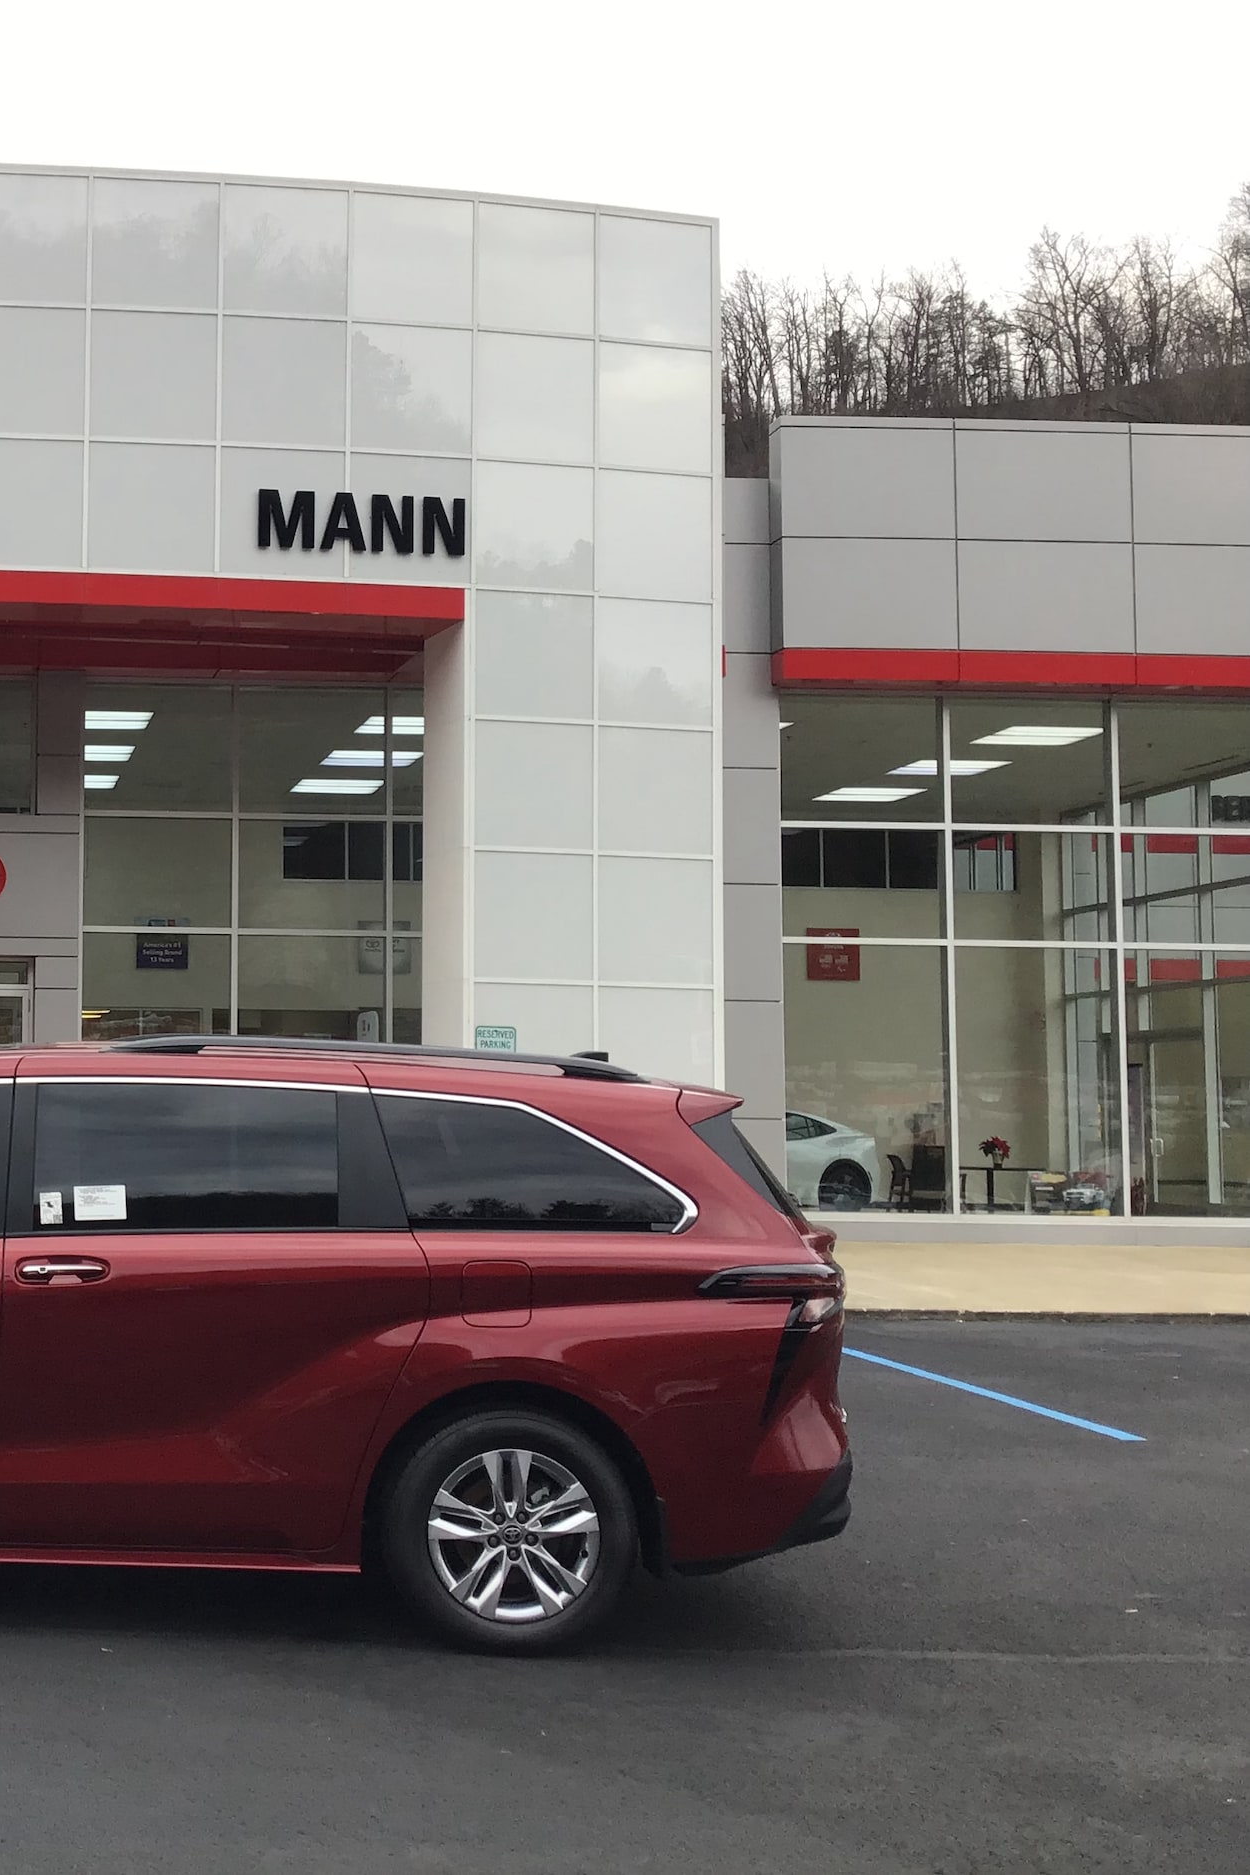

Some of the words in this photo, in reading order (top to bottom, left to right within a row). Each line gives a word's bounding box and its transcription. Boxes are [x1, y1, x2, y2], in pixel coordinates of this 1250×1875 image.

[257, 488, 466, 556] MANN
[142, 949, 163, 957] Selling
[477, 1029, 514, 1040] RESERVED
[480, 1040, 512, 1050] PARKING
